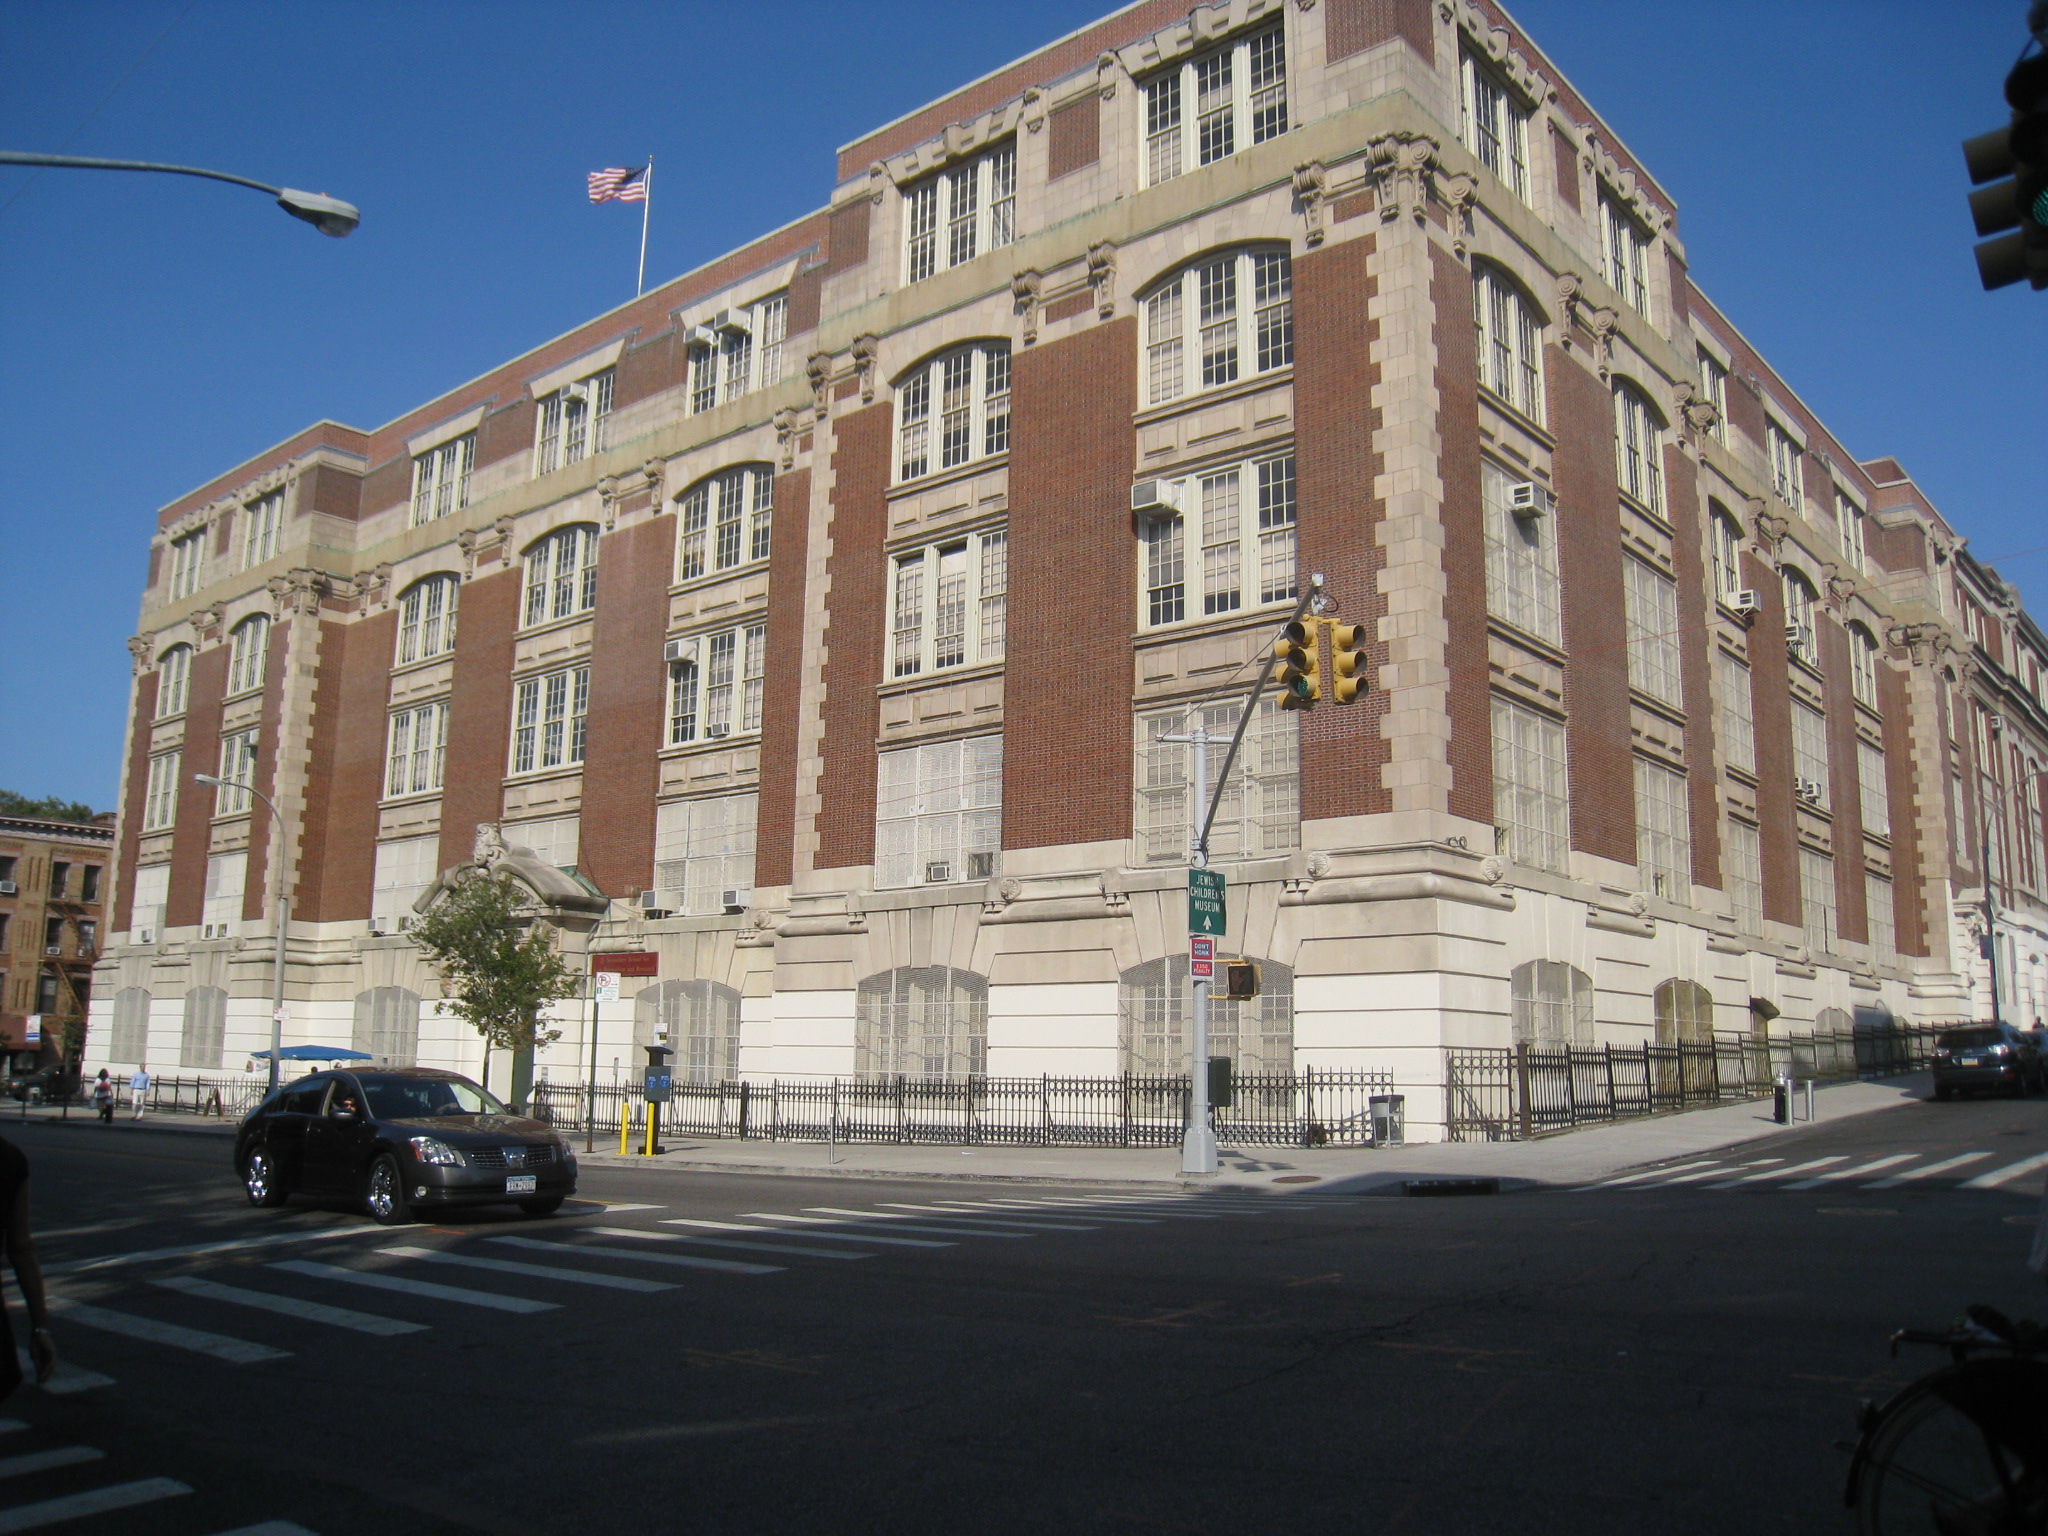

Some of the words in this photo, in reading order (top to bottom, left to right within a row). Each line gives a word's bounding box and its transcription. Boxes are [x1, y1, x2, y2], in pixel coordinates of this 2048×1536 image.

[1190, 886, 1225, 901] CHILDRENS
[1194, 900, 1220, 912] MUSEUM
[1194, 949, 1209, 957] HONK
